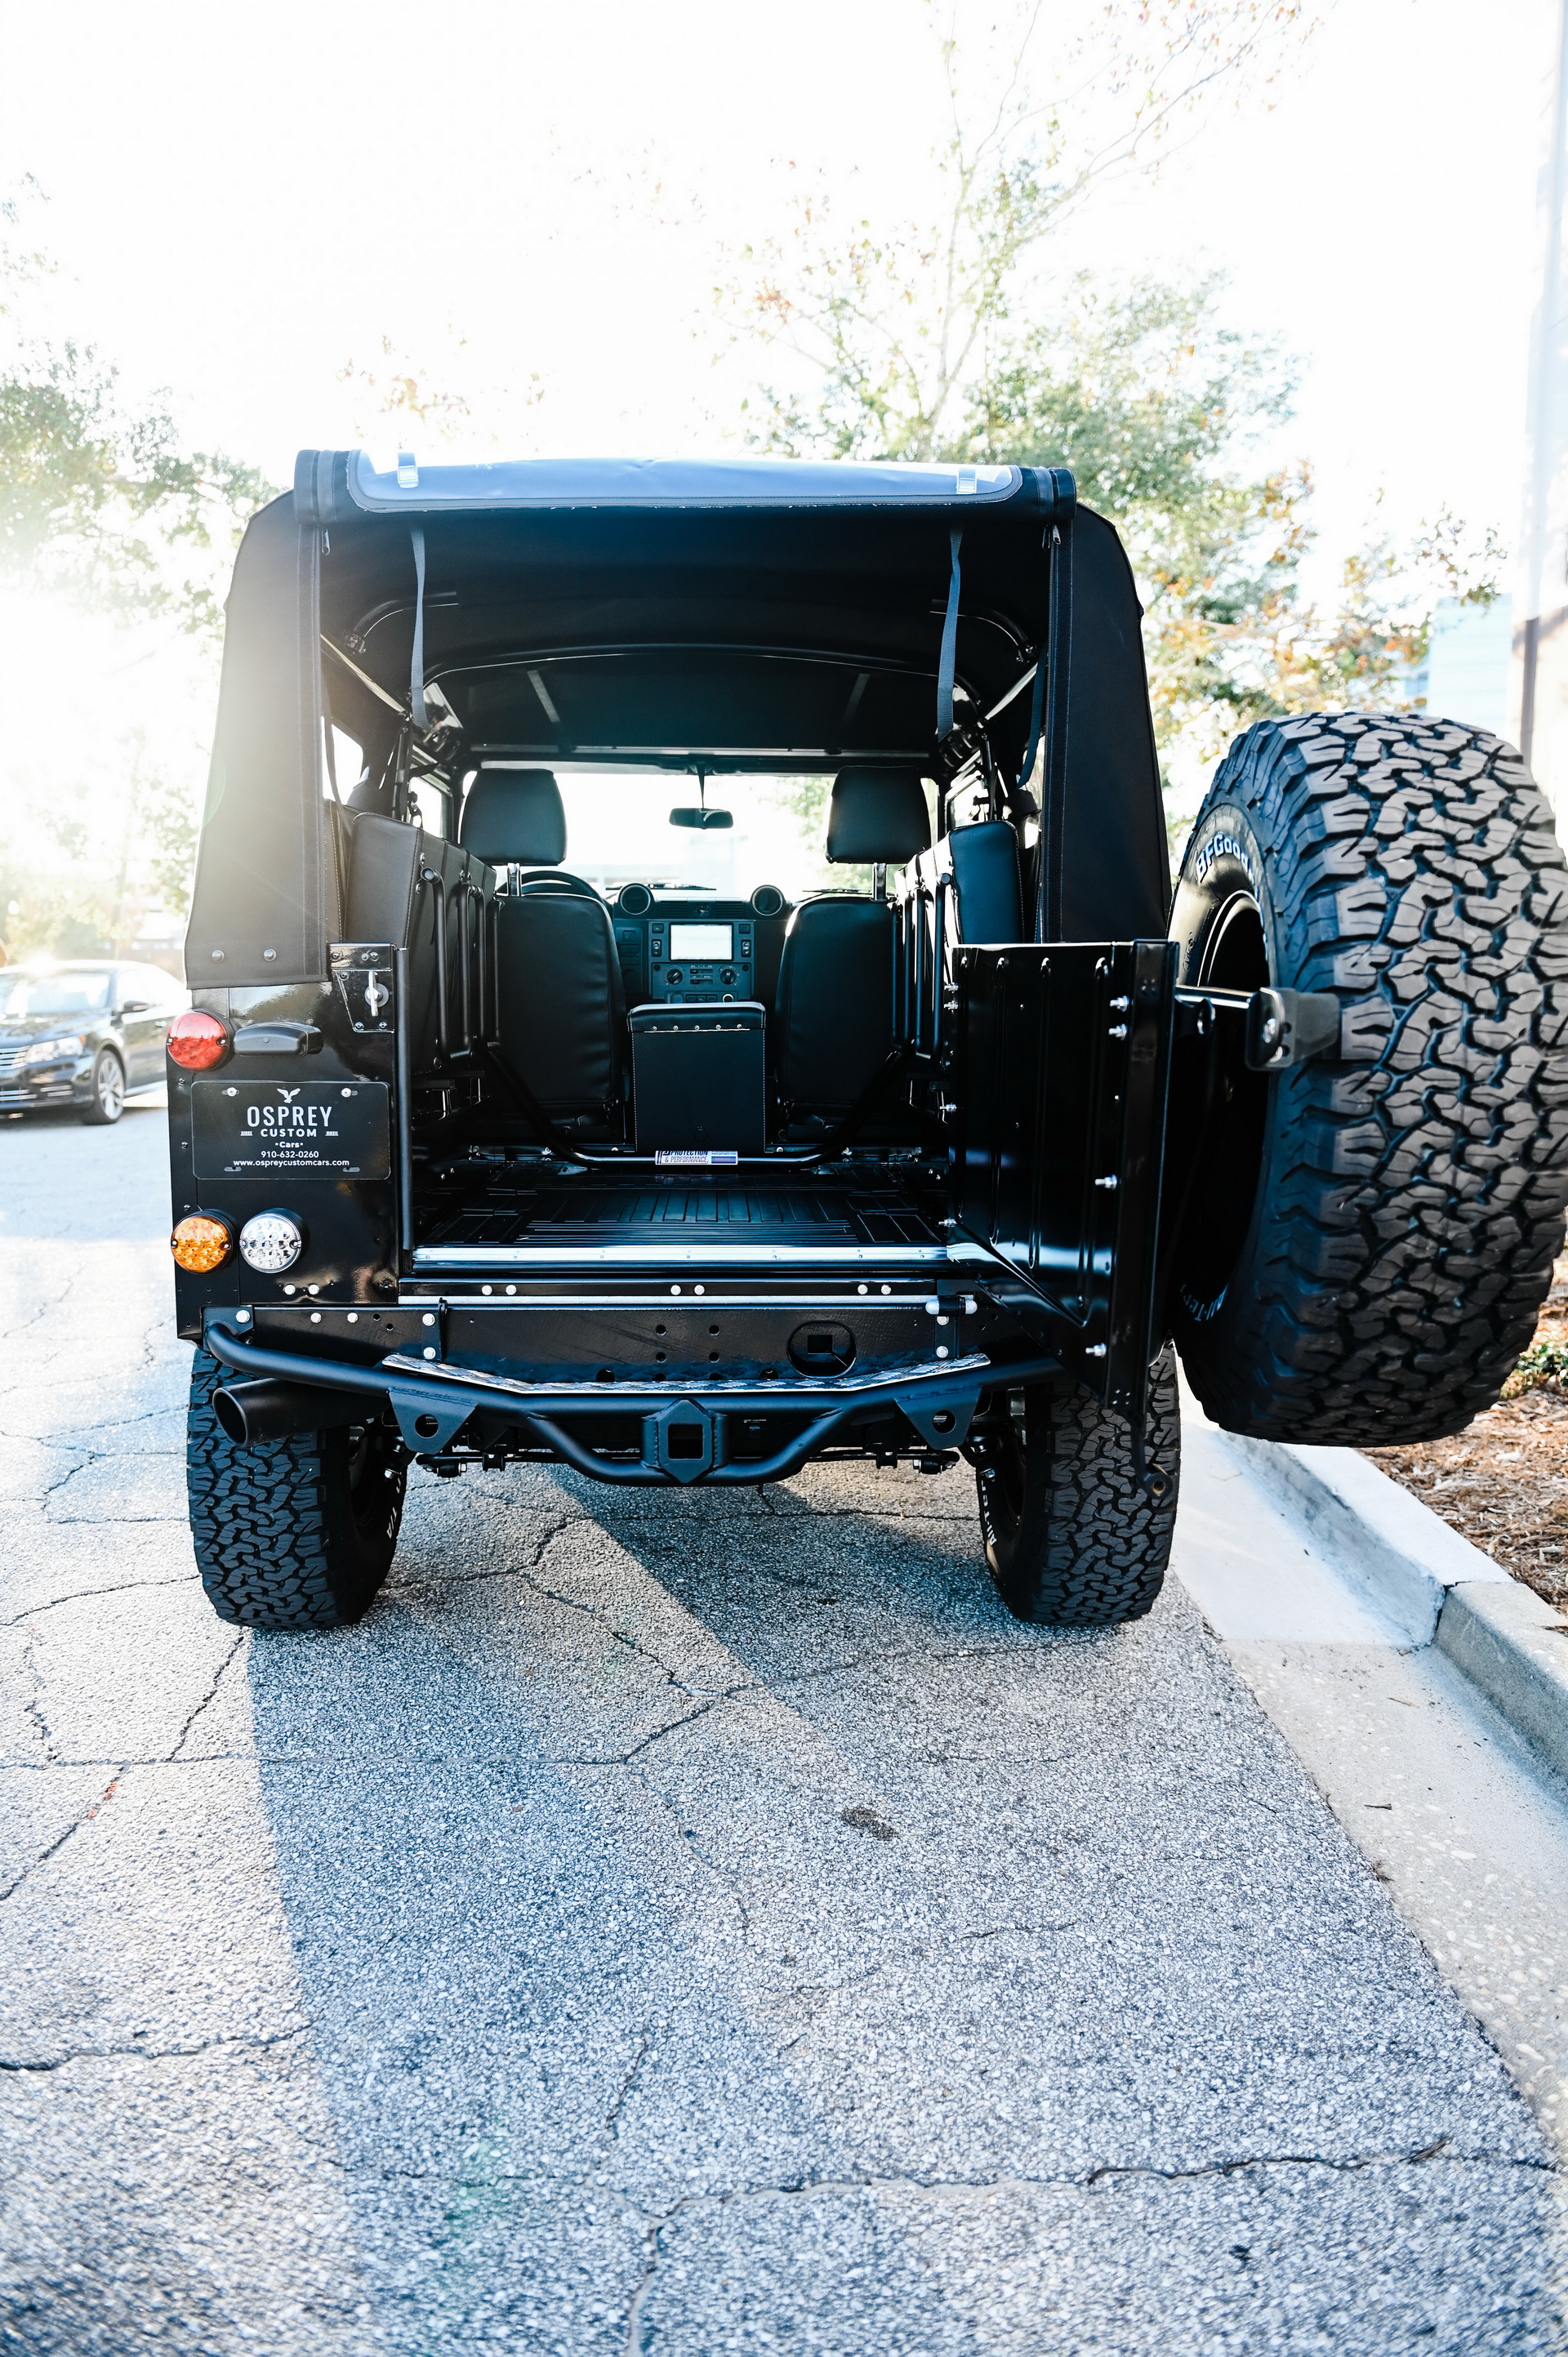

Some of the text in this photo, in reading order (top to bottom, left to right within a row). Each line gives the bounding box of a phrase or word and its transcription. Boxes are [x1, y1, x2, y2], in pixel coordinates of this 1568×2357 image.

[247, 1106, 332, 1127] OSPREY
[260, 1128, 317, 1138] CUSTOM
[261, 1151, 319, 1159] 910-632-0260
[233, 1160, 350, 1168] www.ospreycustomcars.com
